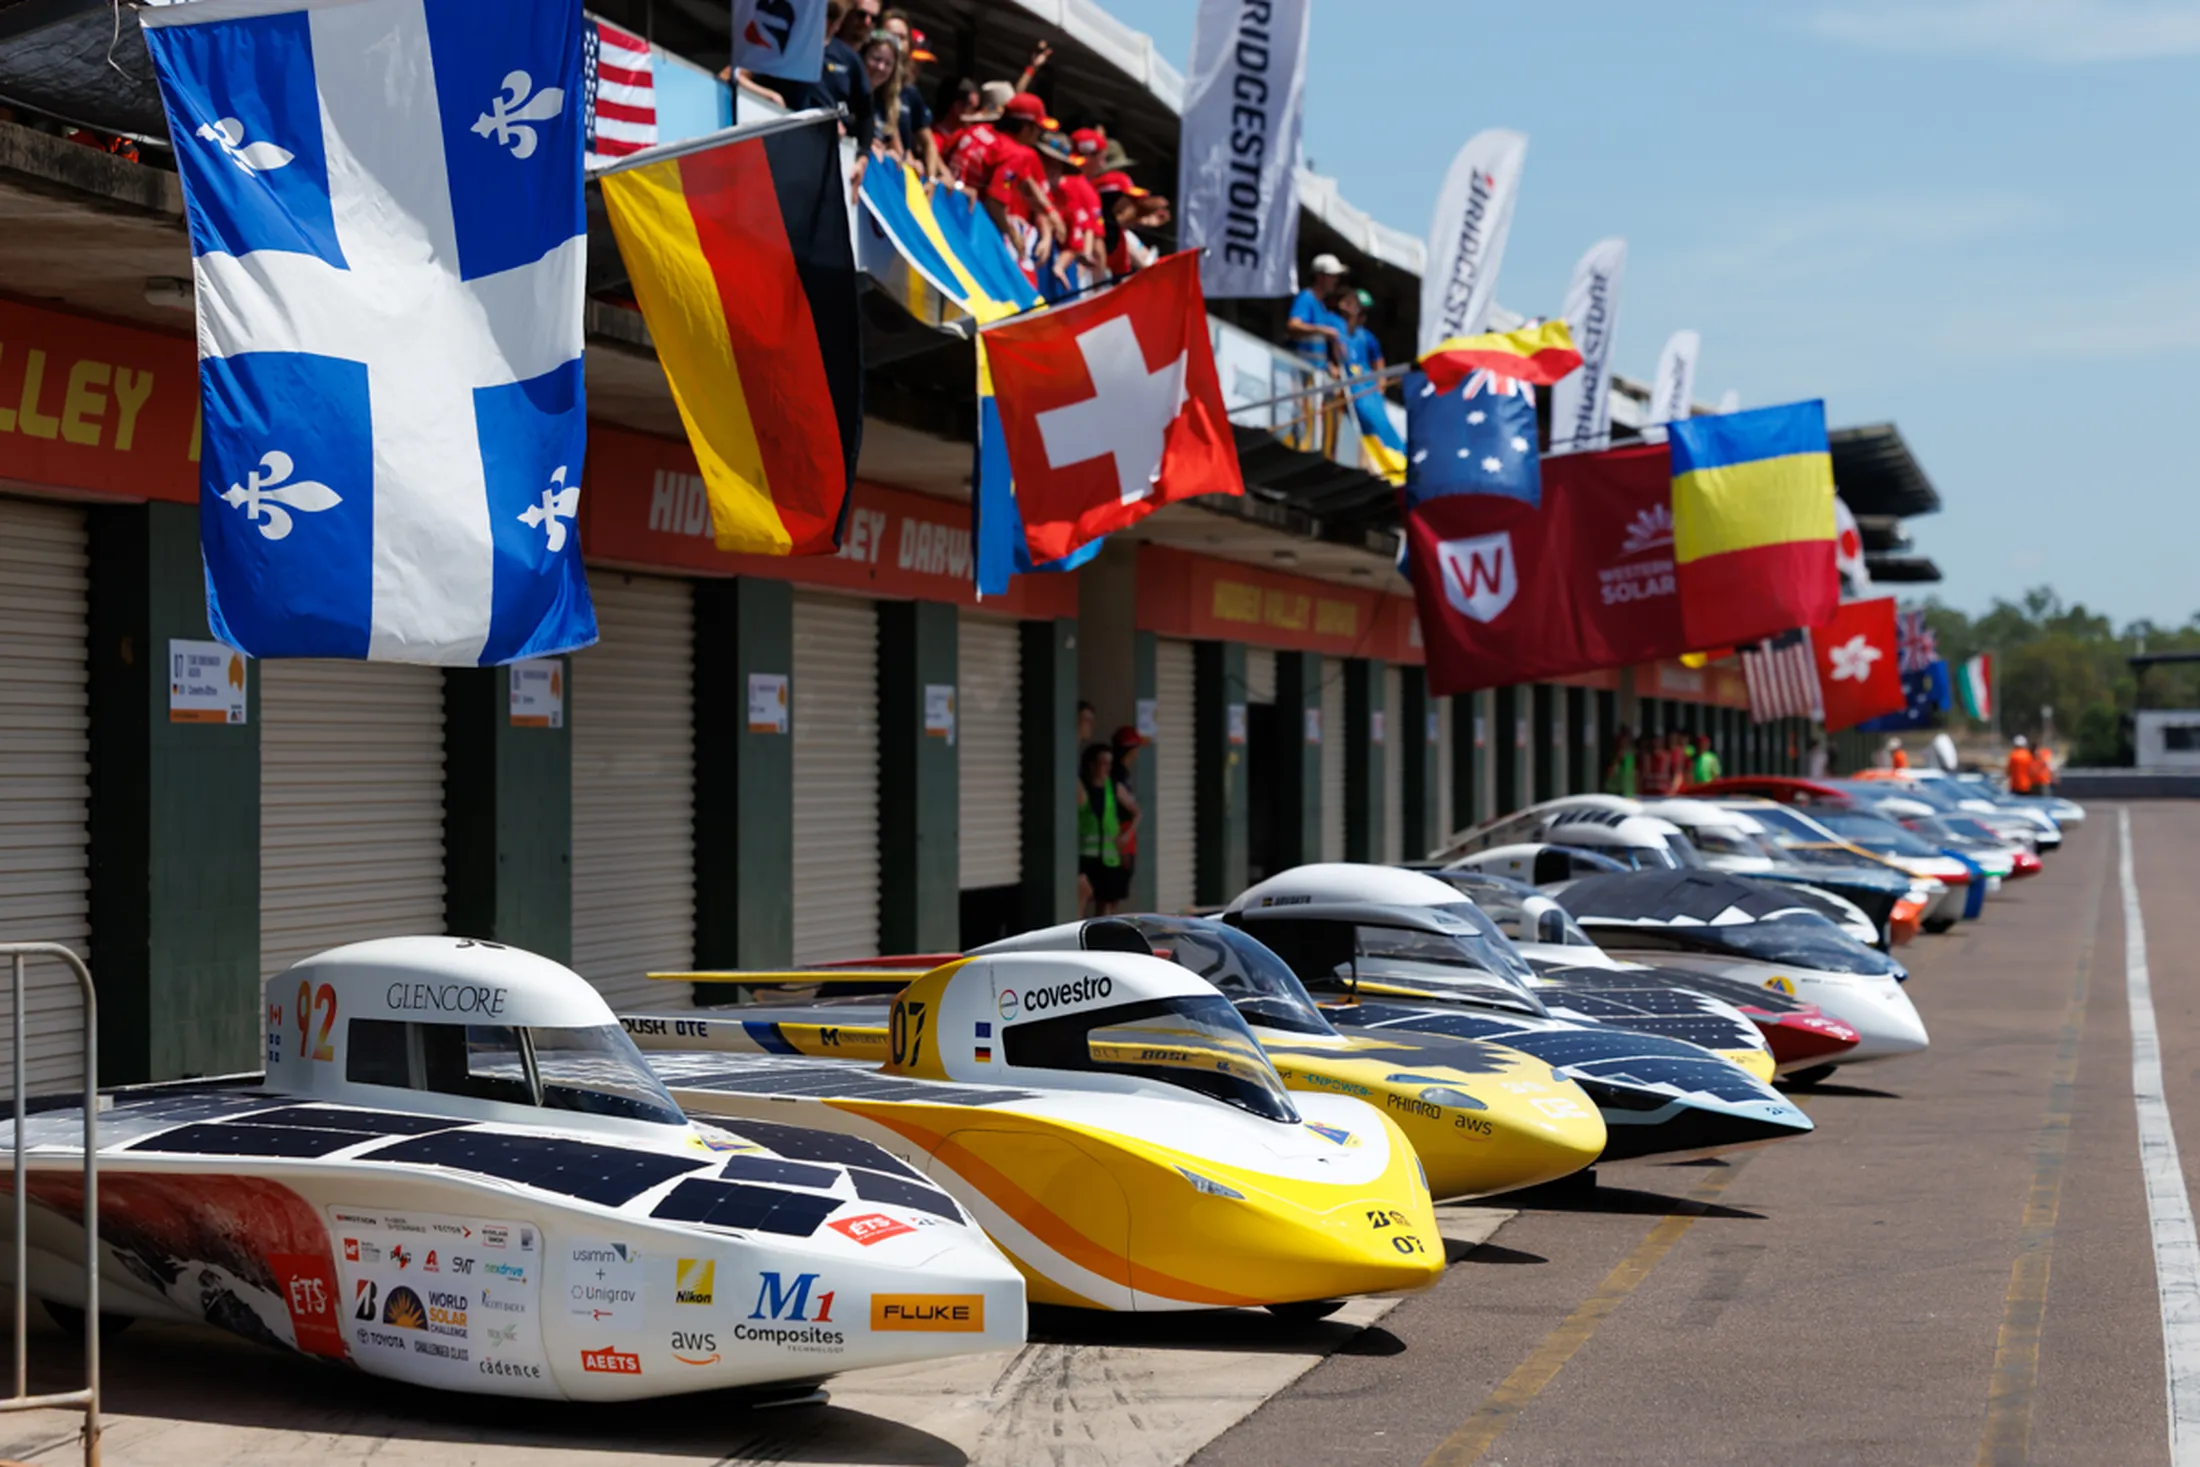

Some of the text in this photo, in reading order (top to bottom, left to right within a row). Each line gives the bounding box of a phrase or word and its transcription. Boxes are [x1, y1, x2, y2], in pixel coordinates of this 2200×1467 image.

[648, 469, 714, 538] HID
[1448, 546, 1504, 600] W
[1601, 575, 1676, 605] SOLAR
[387, 983, 508, 1018] GLENCORE
[1024, 976, 1113, 1011] covestro
[297, 980, 337, 1063] 92
[892, 1000, 927, 1067] 07
[1454, 1114, 1493, 1136] aws
[573, 1249, 615, 1262] usimm
[1392, 1235, 1425, 1254] 07
[290, 1274, 327, 1315] ÉTS
[428, 1290, 468, 1310] WORLD
[675, 1290, 712, 1304] Nikon
[747, 1271, 835, 1323] M1
[429, 1307, 468, 1328] SOLAR
[884, 1305, 970, 1320] FLUKE
[370, 1332, 407, 1350] TOYOTA
[429, 1323, 468, 1340] CHALLENGE
[671, 1331, 717, 1352] aws
[734, 1324, 844, 1346] Composites
[587, 1354, 637, 1371] AEETS
